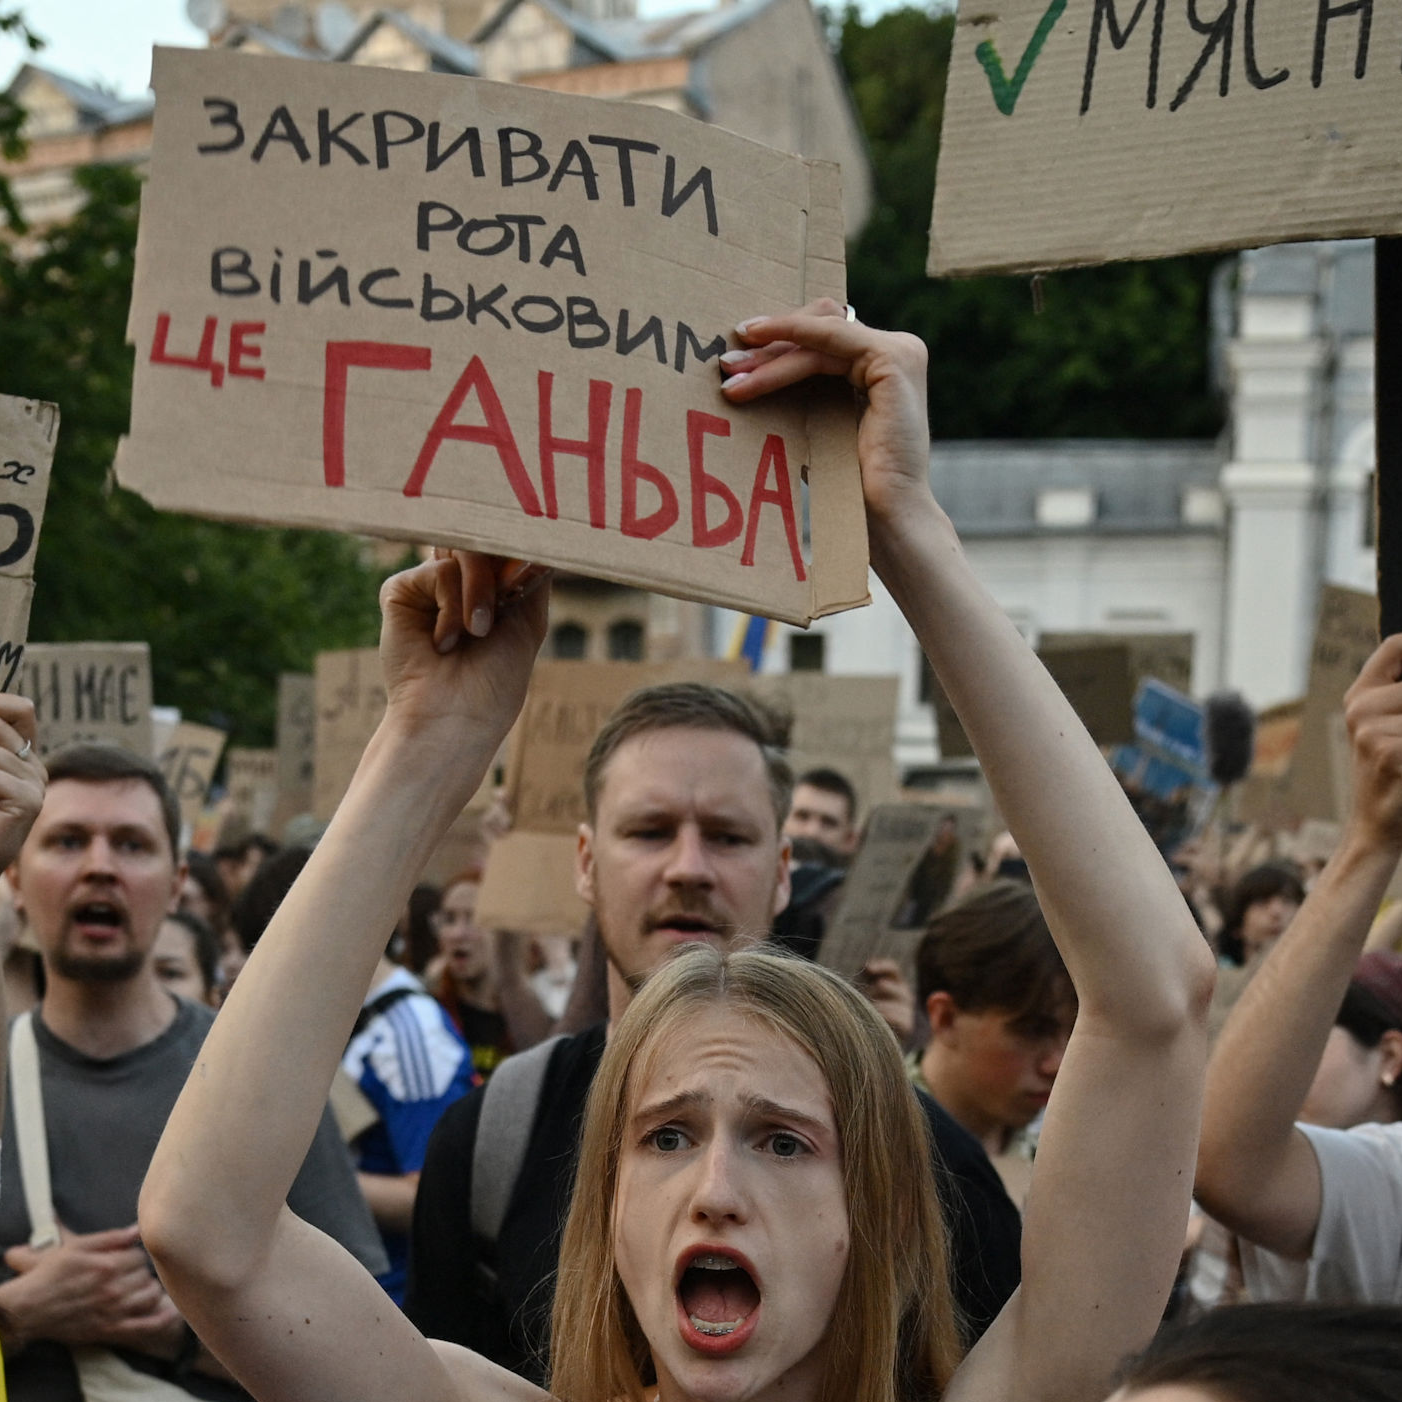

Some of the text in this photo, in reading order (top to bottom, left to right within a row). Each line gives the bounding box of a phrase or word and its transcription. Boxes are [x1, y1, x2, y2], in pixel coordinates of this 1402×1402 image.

[198, 99, 720, 237] ЗАКРИВАТИ
[417, 201, 587, 277] РОТА
[149, 312, 807, 583] ЦЕ ГАНЬБА
